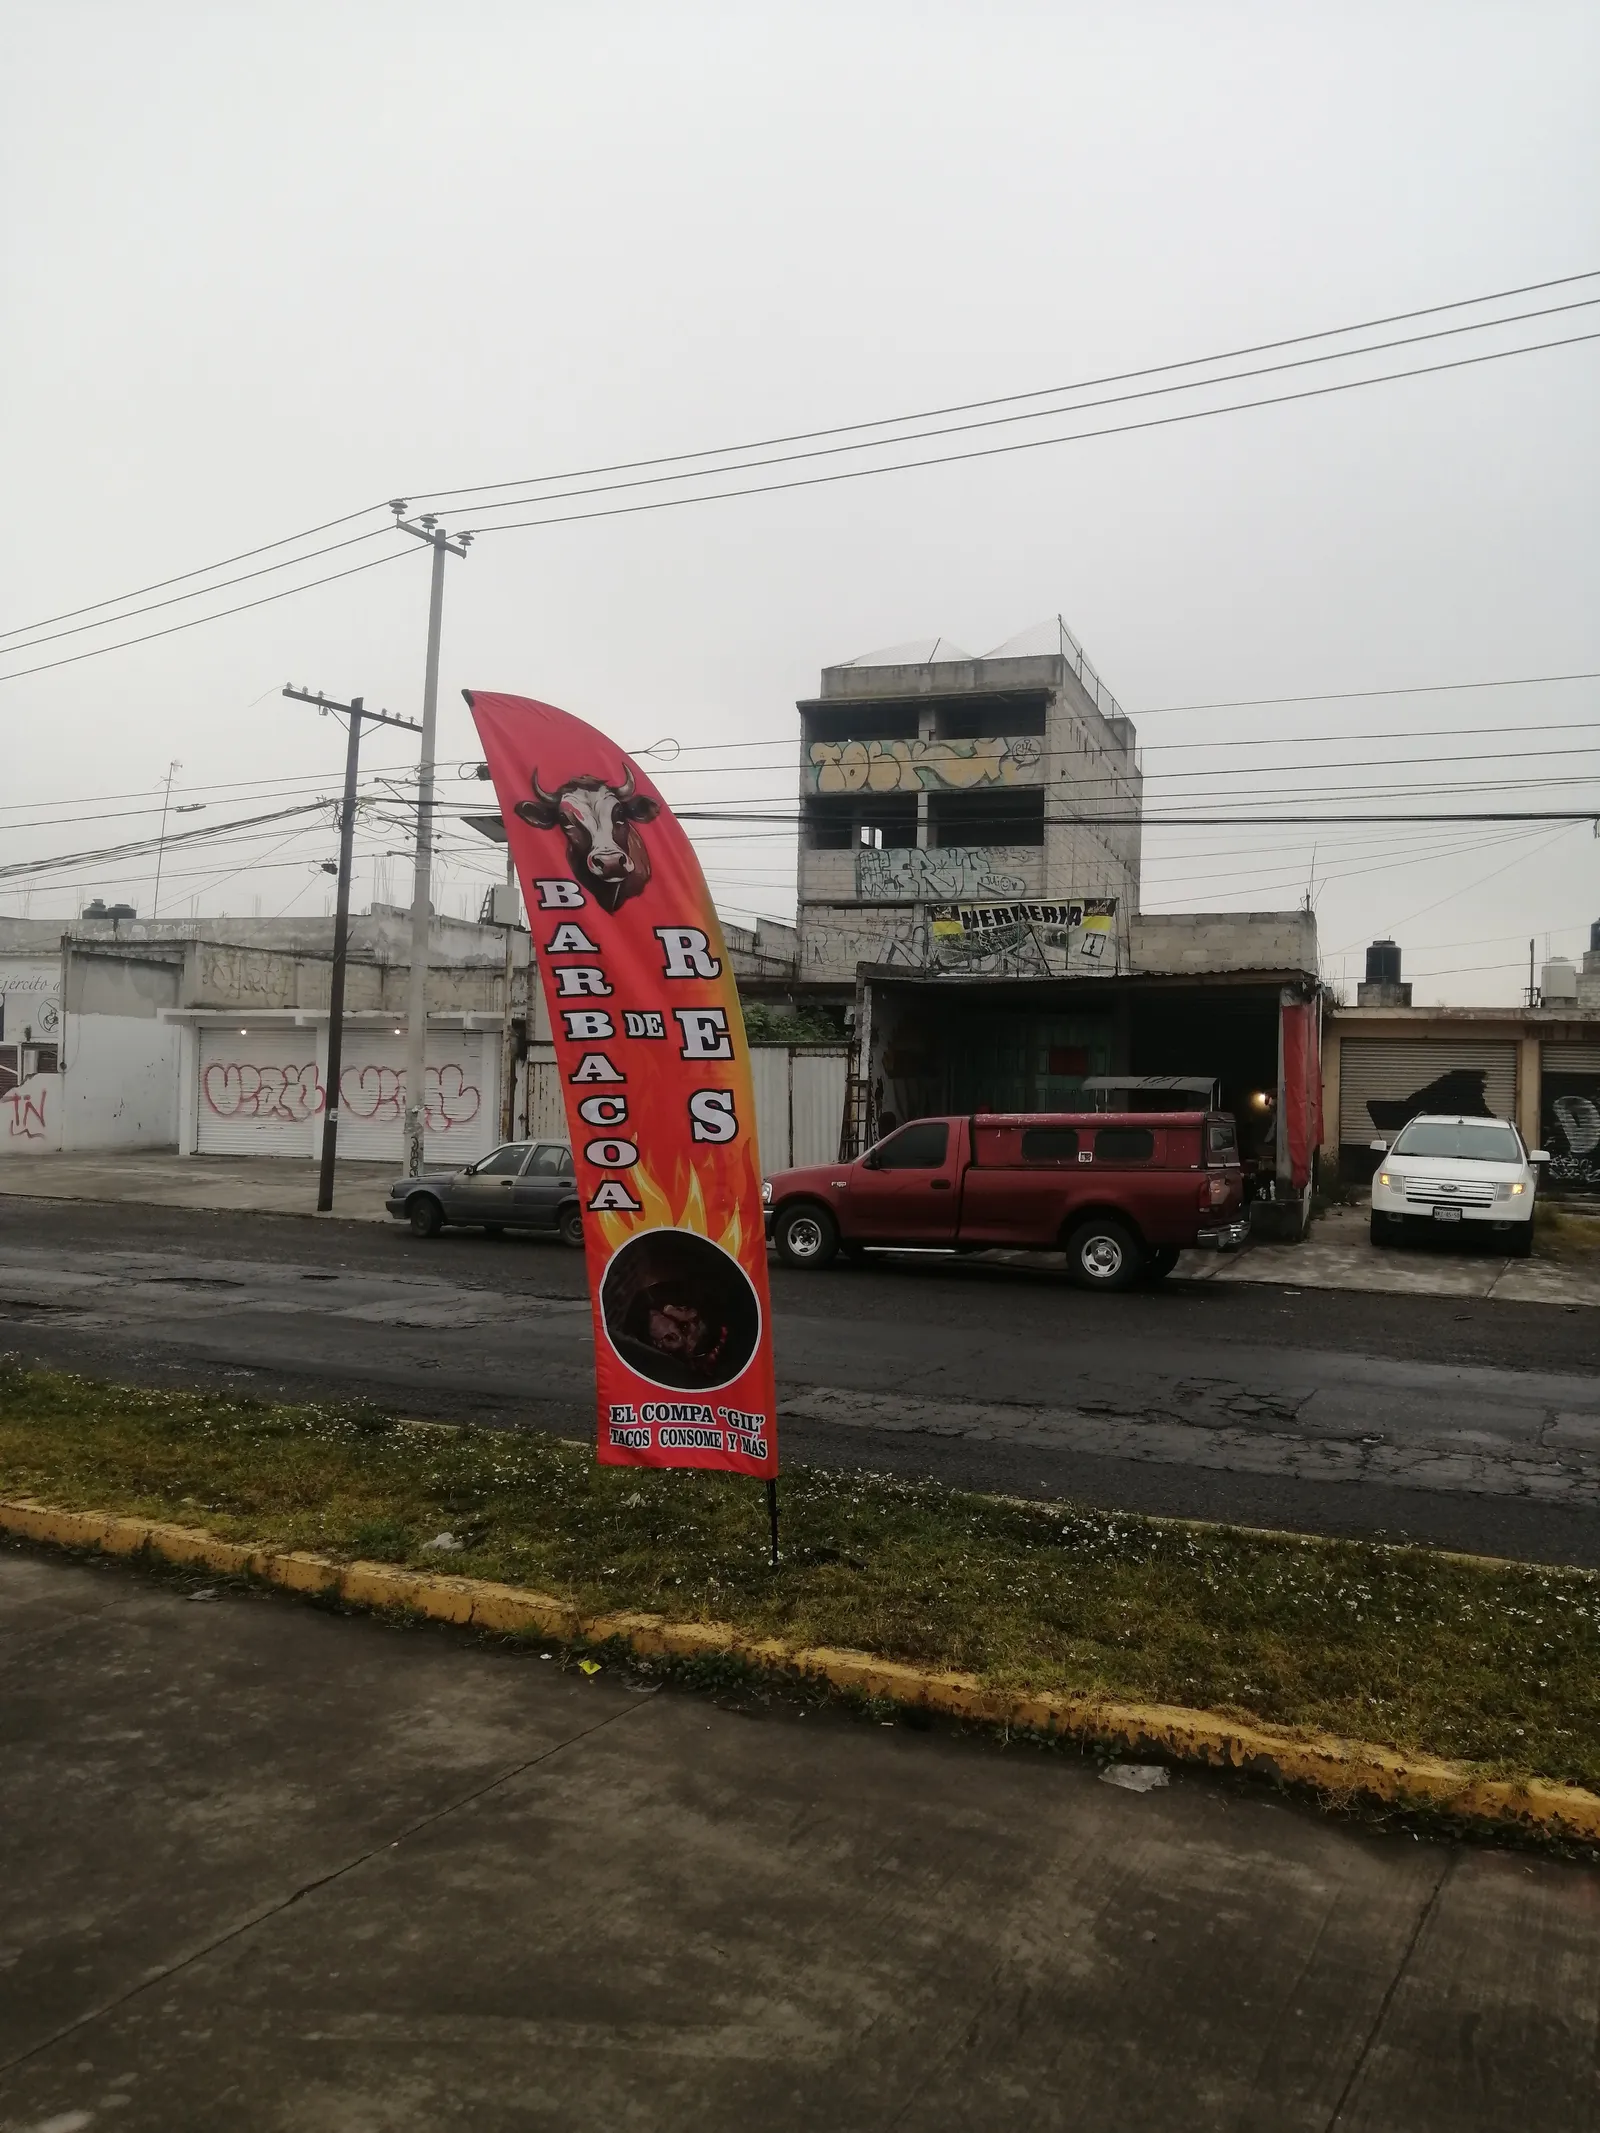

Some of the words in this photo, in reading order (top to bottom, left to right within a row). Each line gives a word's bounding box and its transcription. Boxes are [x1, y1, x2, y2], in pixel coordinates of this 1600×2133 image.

[961, 905, 1082, 929] HERRERIA
[624, 1011, 666, 1040] DE
[655, 926, 740, 1143] RES
[533, 879, 643, 1212] BARBACOA
[610, 1404, 637, 1424] EL
[640, 1403, 716, 1424] COMPA
[610, 1428, 651, 1448] TACOS
[659, 1427, 723, 1450] CONSOME
[727, 1431, 738, 1452] Y
[741, 1434, 767, 1459] MÁS
